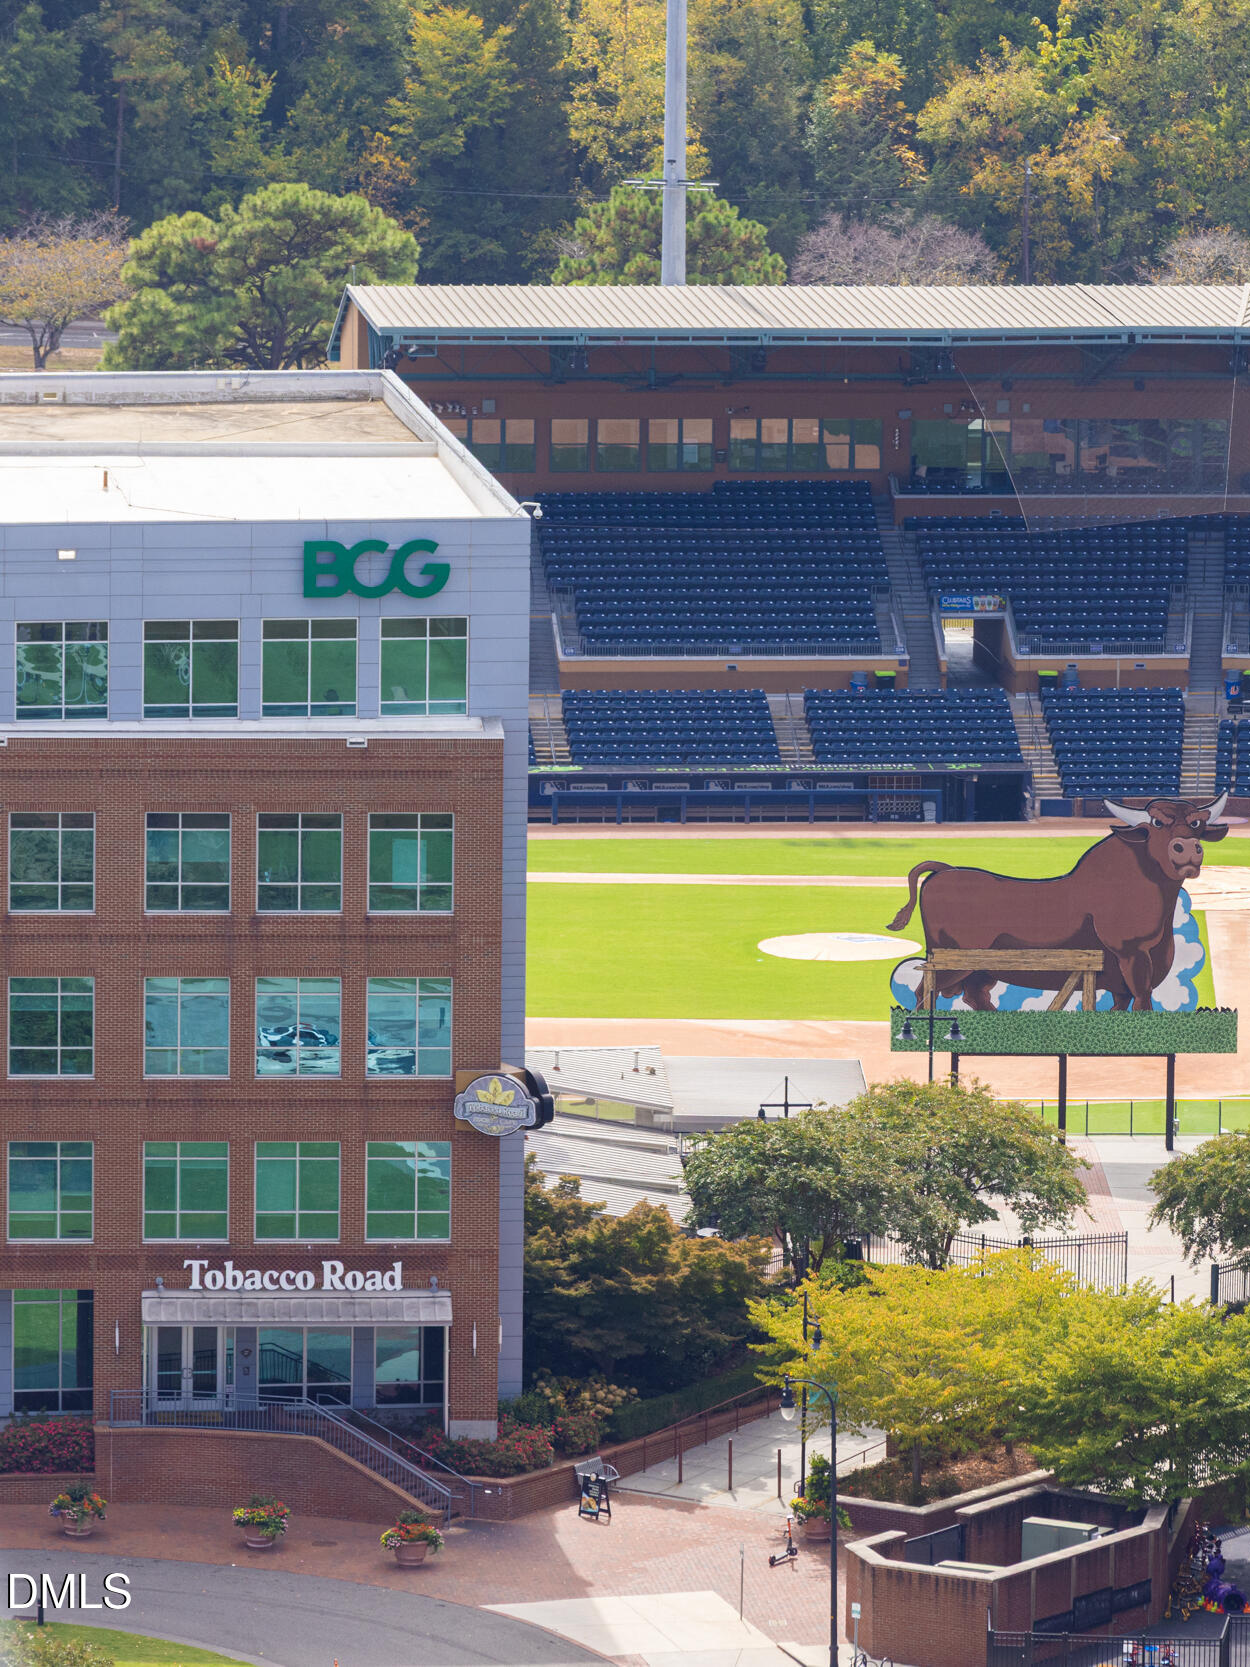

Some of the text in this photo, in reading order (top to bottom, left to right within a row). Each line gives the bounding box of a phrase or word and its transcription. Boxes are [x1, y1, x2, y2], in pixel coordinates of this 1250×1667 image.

[304, 539, 451, 598] BCG
[183, 1259, 403, 1291] Tobacco Road
